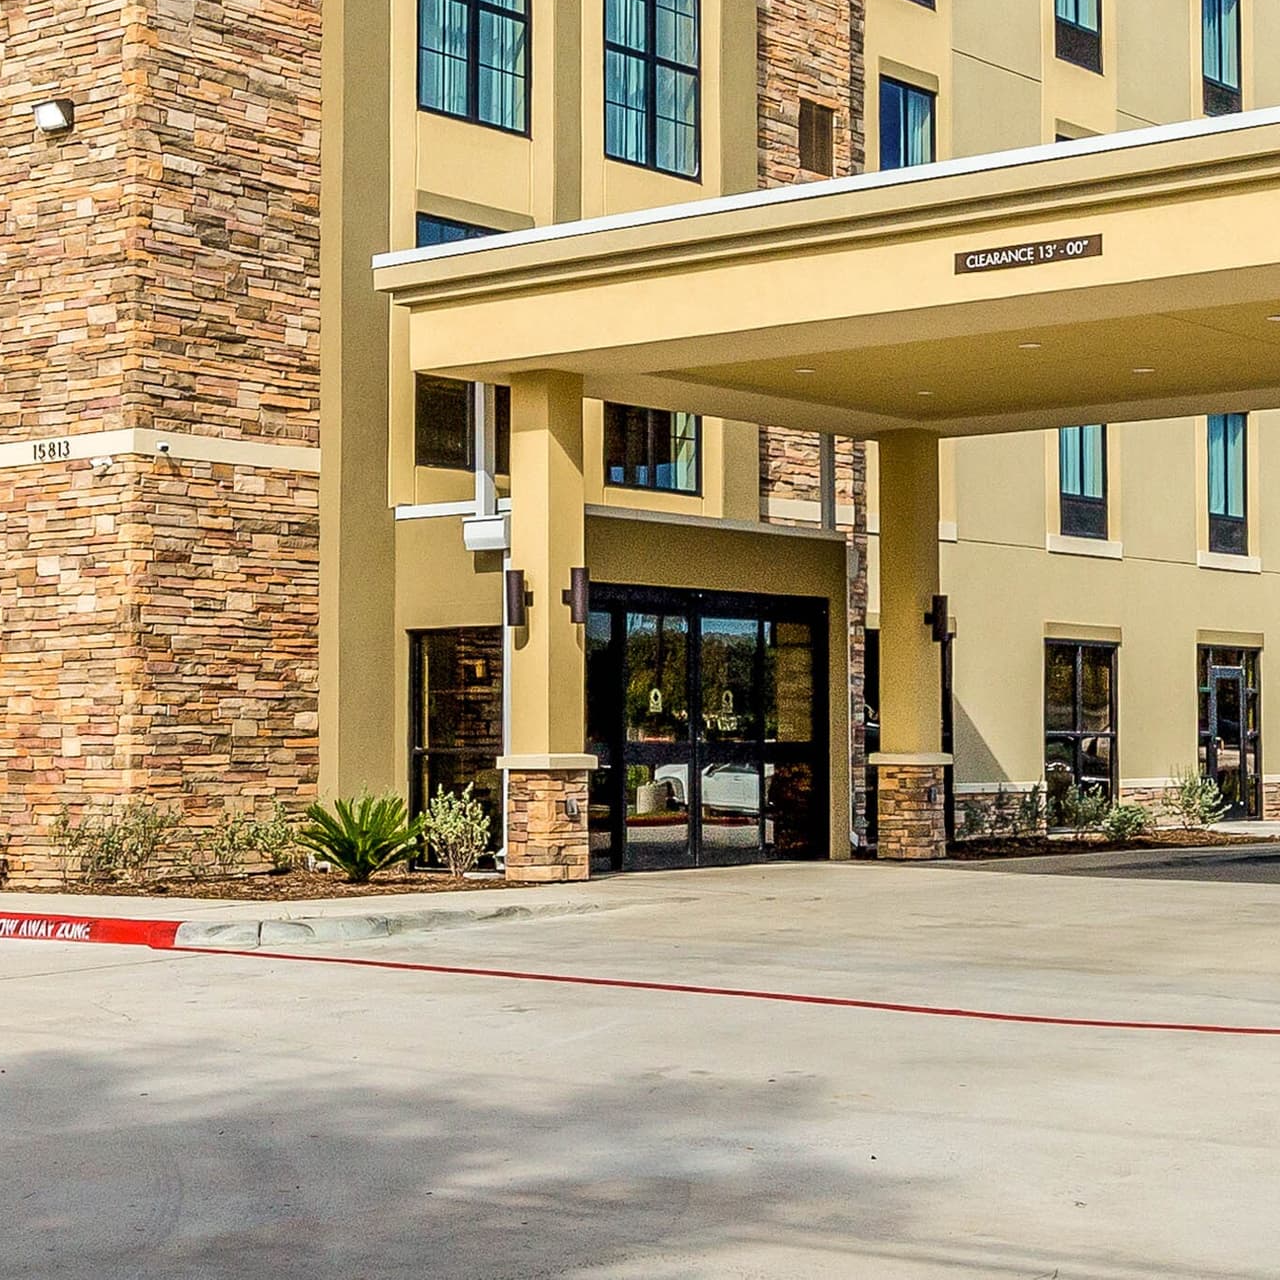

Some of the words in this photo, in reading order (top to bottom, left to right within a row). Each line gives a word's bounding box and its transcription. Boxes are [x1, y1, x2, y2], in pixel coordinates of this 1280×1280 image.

[966, 247, 1034, 268] CLEARANCE
[33, 440, 70, 460] 15813
[18, 919, 55, 938] AWAY
